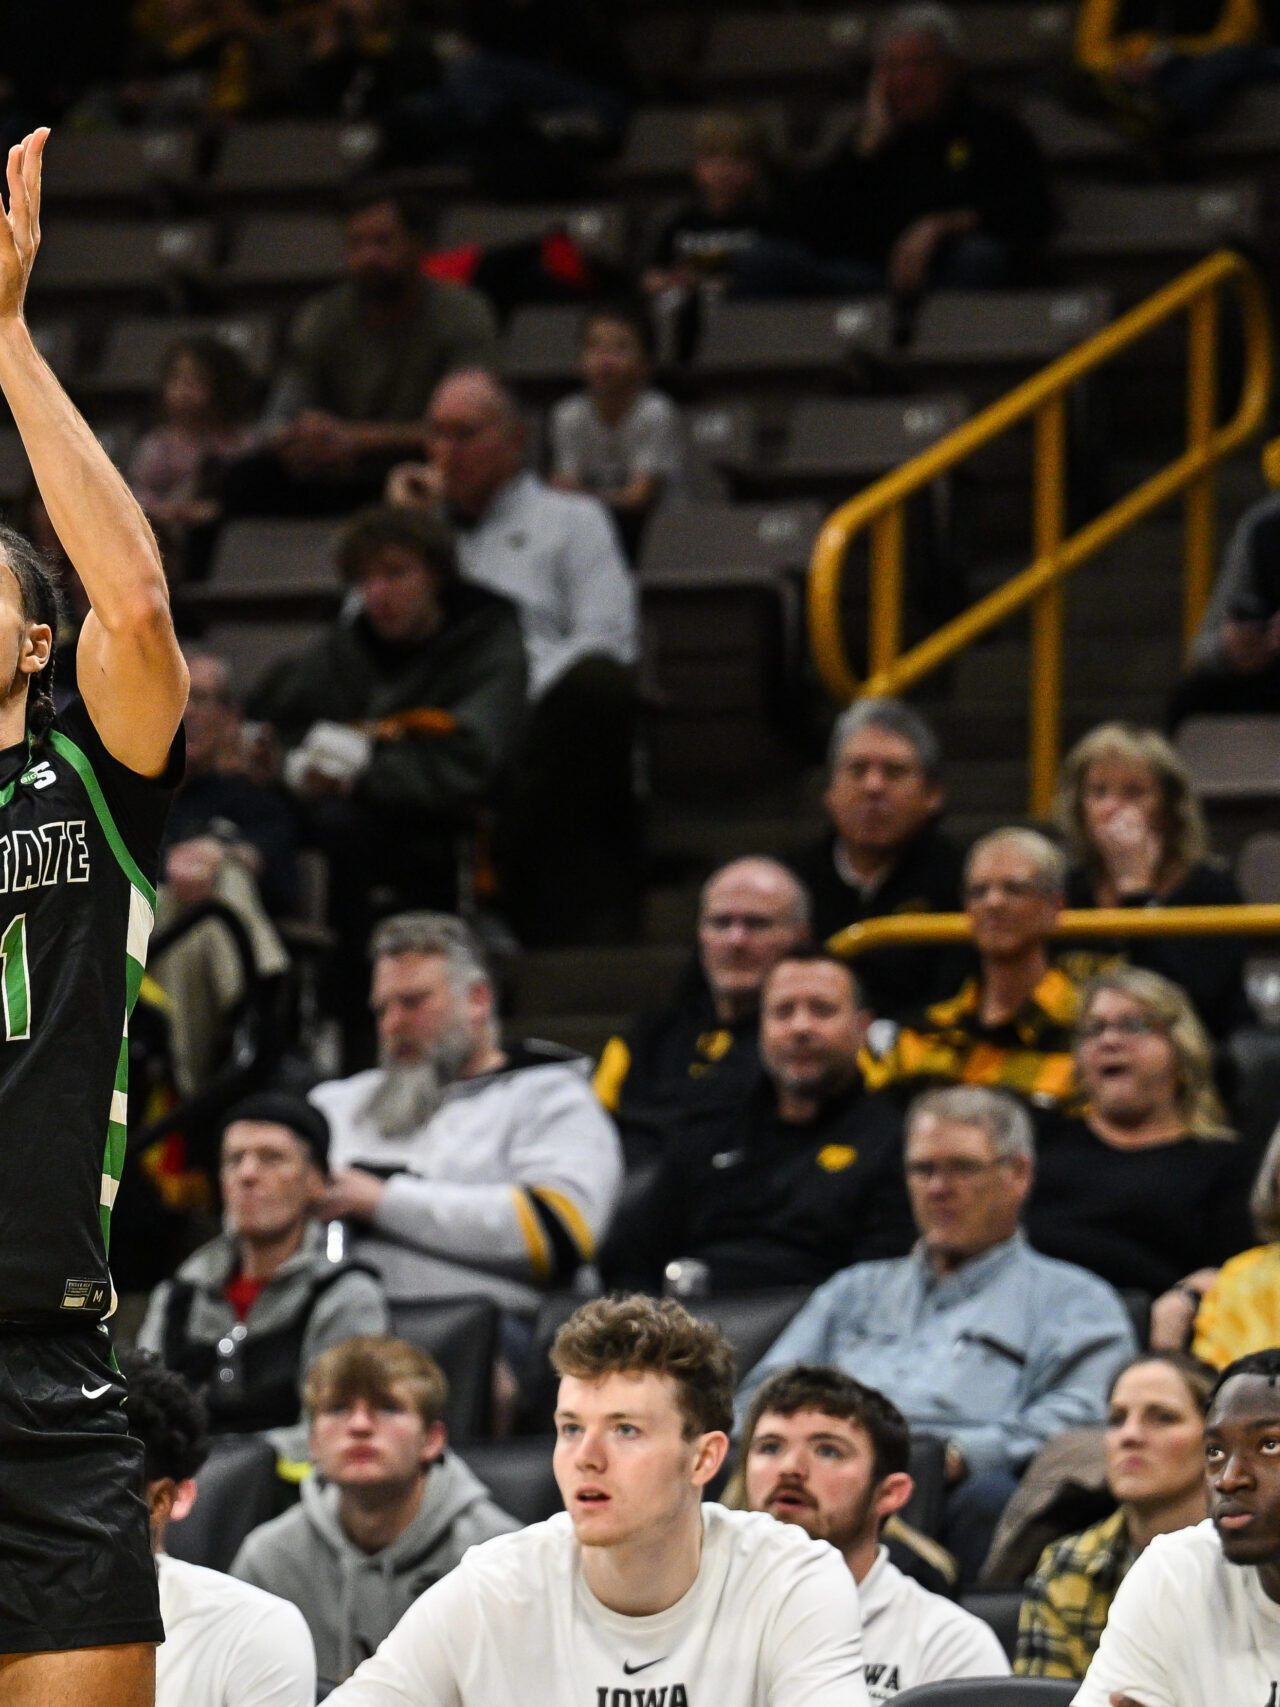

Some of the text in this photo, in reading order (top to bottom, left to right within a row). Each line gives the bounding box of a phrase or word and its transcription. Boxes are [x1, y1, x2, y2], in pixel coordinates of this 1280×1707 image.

[92, 1289, 104, 1303] M
[863, 1664, 899, 1691] WA
[596, 1682, 688, 1707] IOWA
